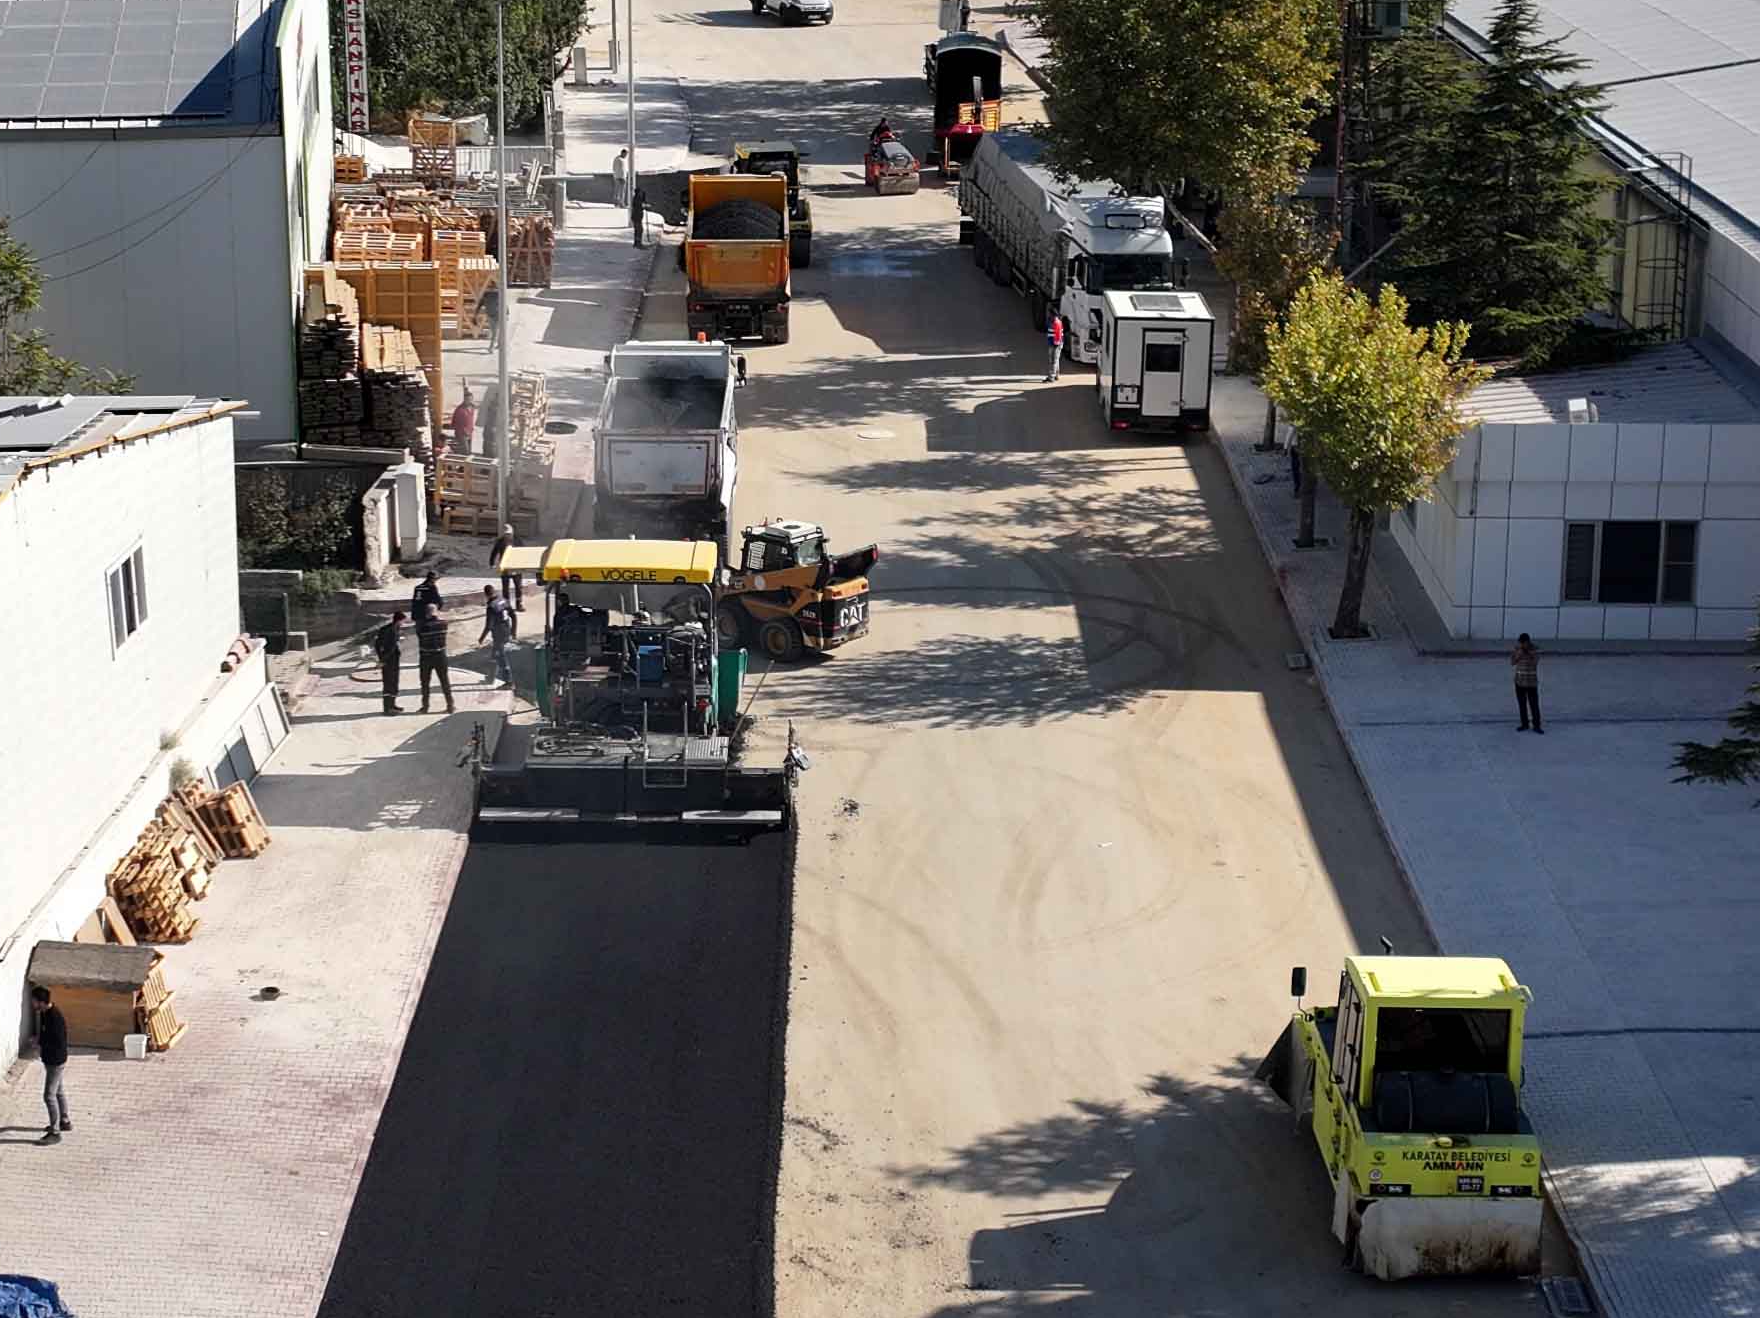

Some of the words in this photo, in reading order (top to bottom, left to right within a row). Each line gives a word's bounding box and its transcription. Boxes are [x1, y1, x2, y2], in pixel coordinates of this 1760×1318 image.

[840, 601, 867, 628] CAT
[1402, 1150, 1449, 1162] KARATAY
[1451, 1149, 1512, 1163] BELEDİYESİ
[1423, 1161, 1484, 1172] AMMANN
